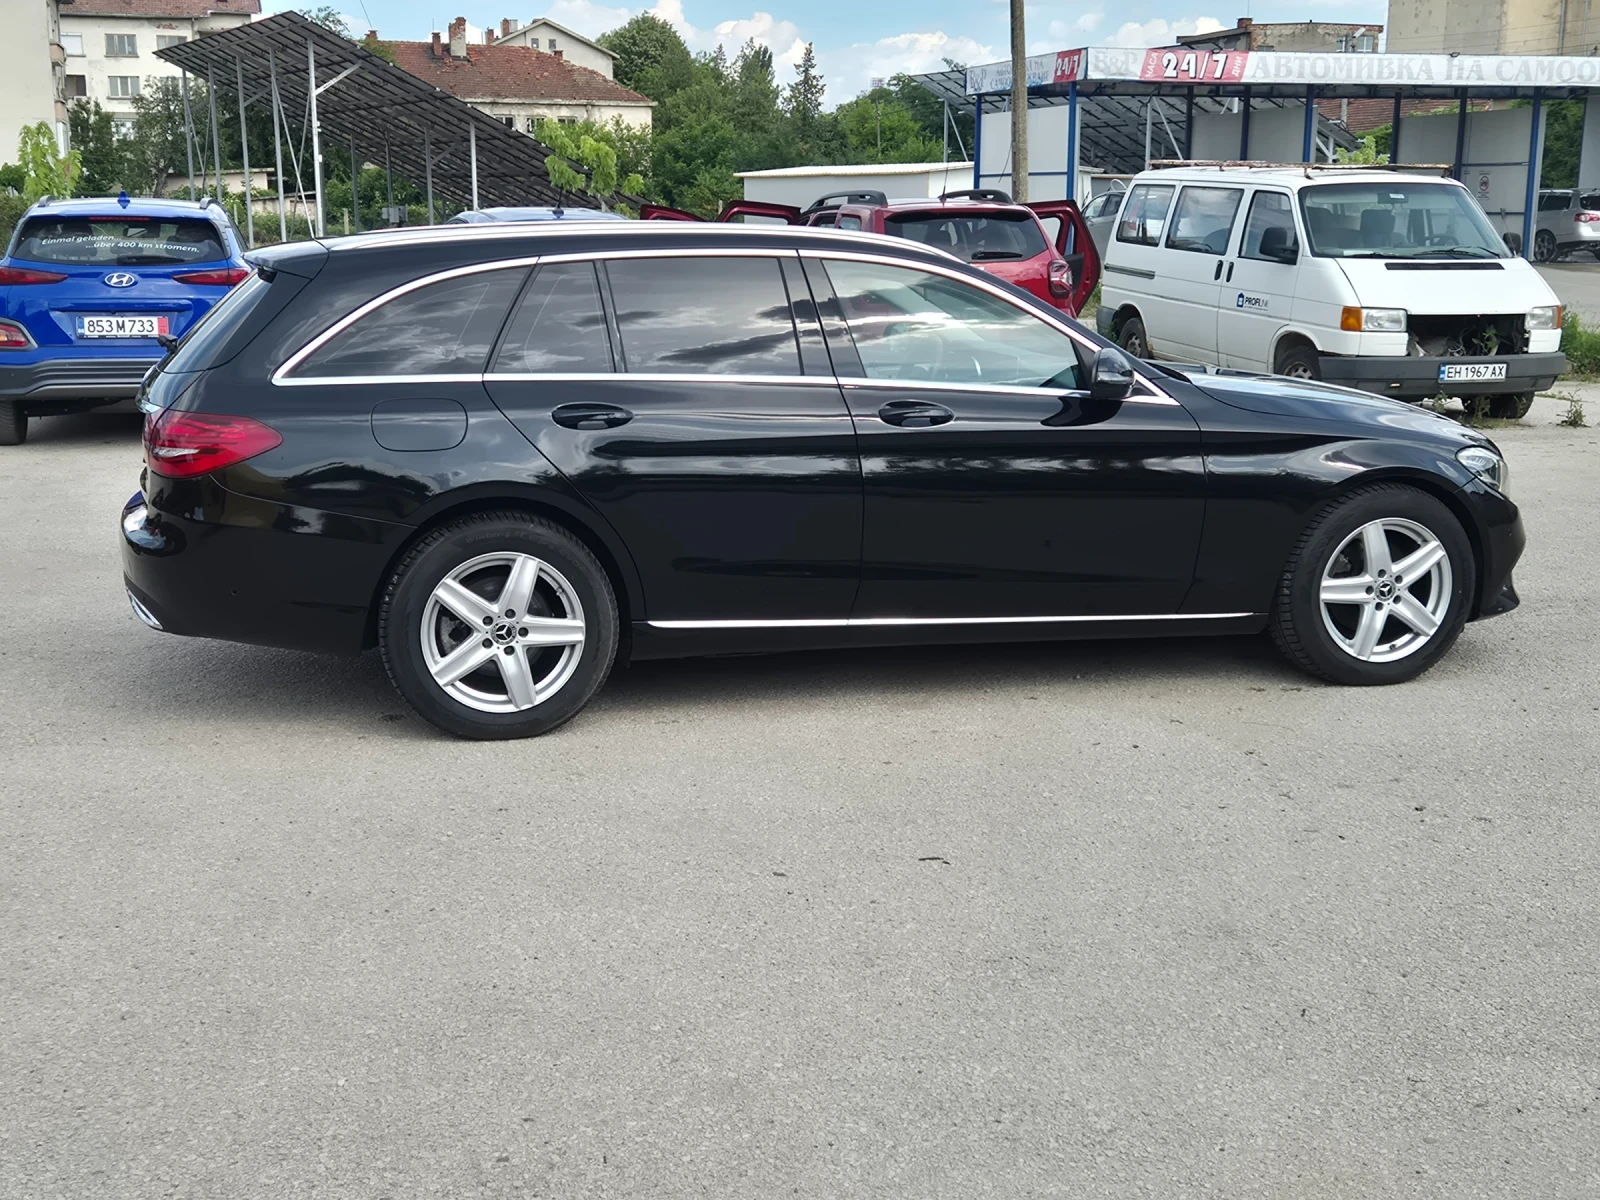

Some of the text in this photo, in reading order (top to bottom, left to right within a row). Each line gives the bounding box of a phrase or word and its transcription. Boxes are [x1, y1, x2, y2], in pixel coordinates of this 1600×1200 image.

[1056, 54, 1080, 77] 24/7
[1091, 51, 1138, 74] B&P
[1161, 51, 1228, 79] 24/7
[1231, 56, 1243, 77] ДНИ
[1252, 55, 1600, 82] АВТОМИВКА НА САМОО
[42, 235, 121, 245] Einmal geladen...
[155, 243, 200, 252] stromern.
[1447, 365, 1504, 378] EH 1967 AX
